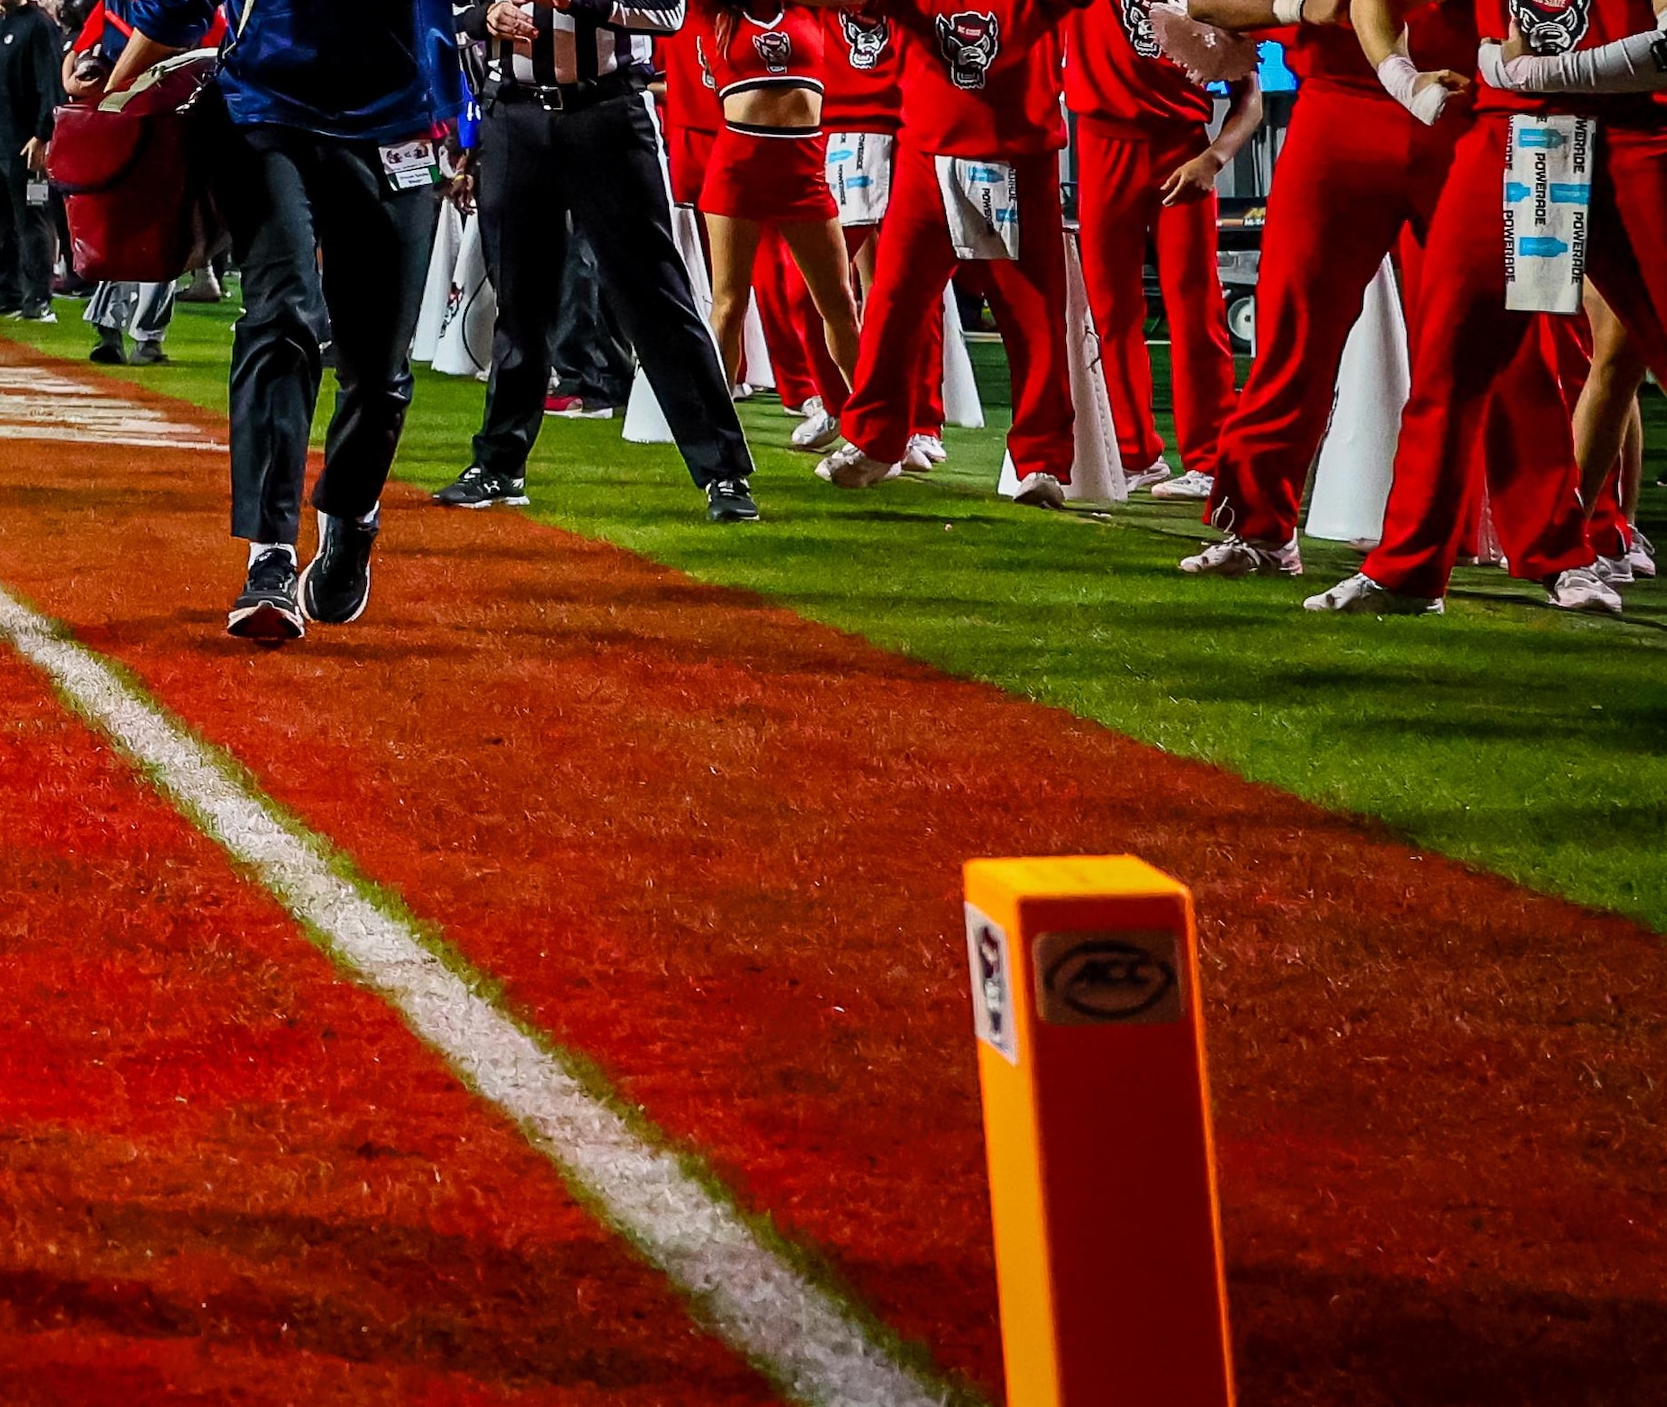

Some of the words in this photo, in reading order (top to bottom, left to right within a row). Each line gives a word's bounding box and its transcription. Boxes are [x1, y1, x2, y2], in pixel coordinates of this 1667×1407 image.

[1573, 115, 1588, 174] WERADE
[1535, 152, 1547, 227] POWERADE
[1503, 209, 1517, 285] POWERADE
[1570, 211, 1585, 286] POWERADE
